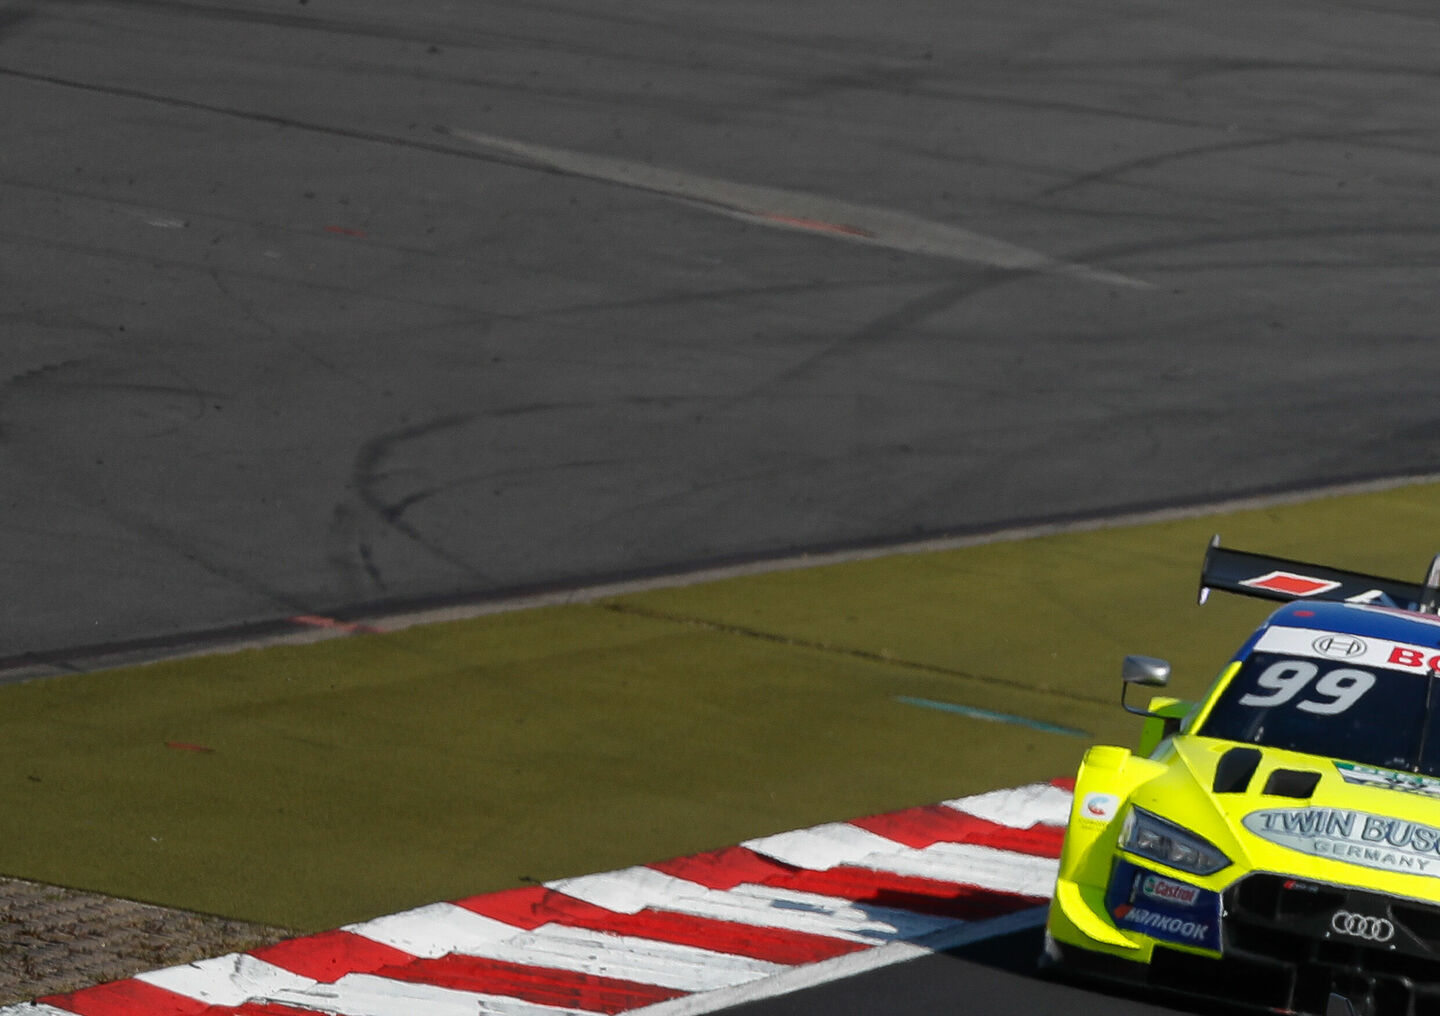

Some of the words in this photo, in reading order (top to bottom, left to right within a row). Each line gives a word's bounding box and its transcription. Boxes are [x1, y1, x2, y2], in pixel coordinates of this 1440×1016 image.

[1238, 660, 1377, 716] 99
[1259, 808, 1357, 839] TWIN
[1314, 838, 1431, 871] GERMANY
[1154, 880, 1196, 902] Castrol
